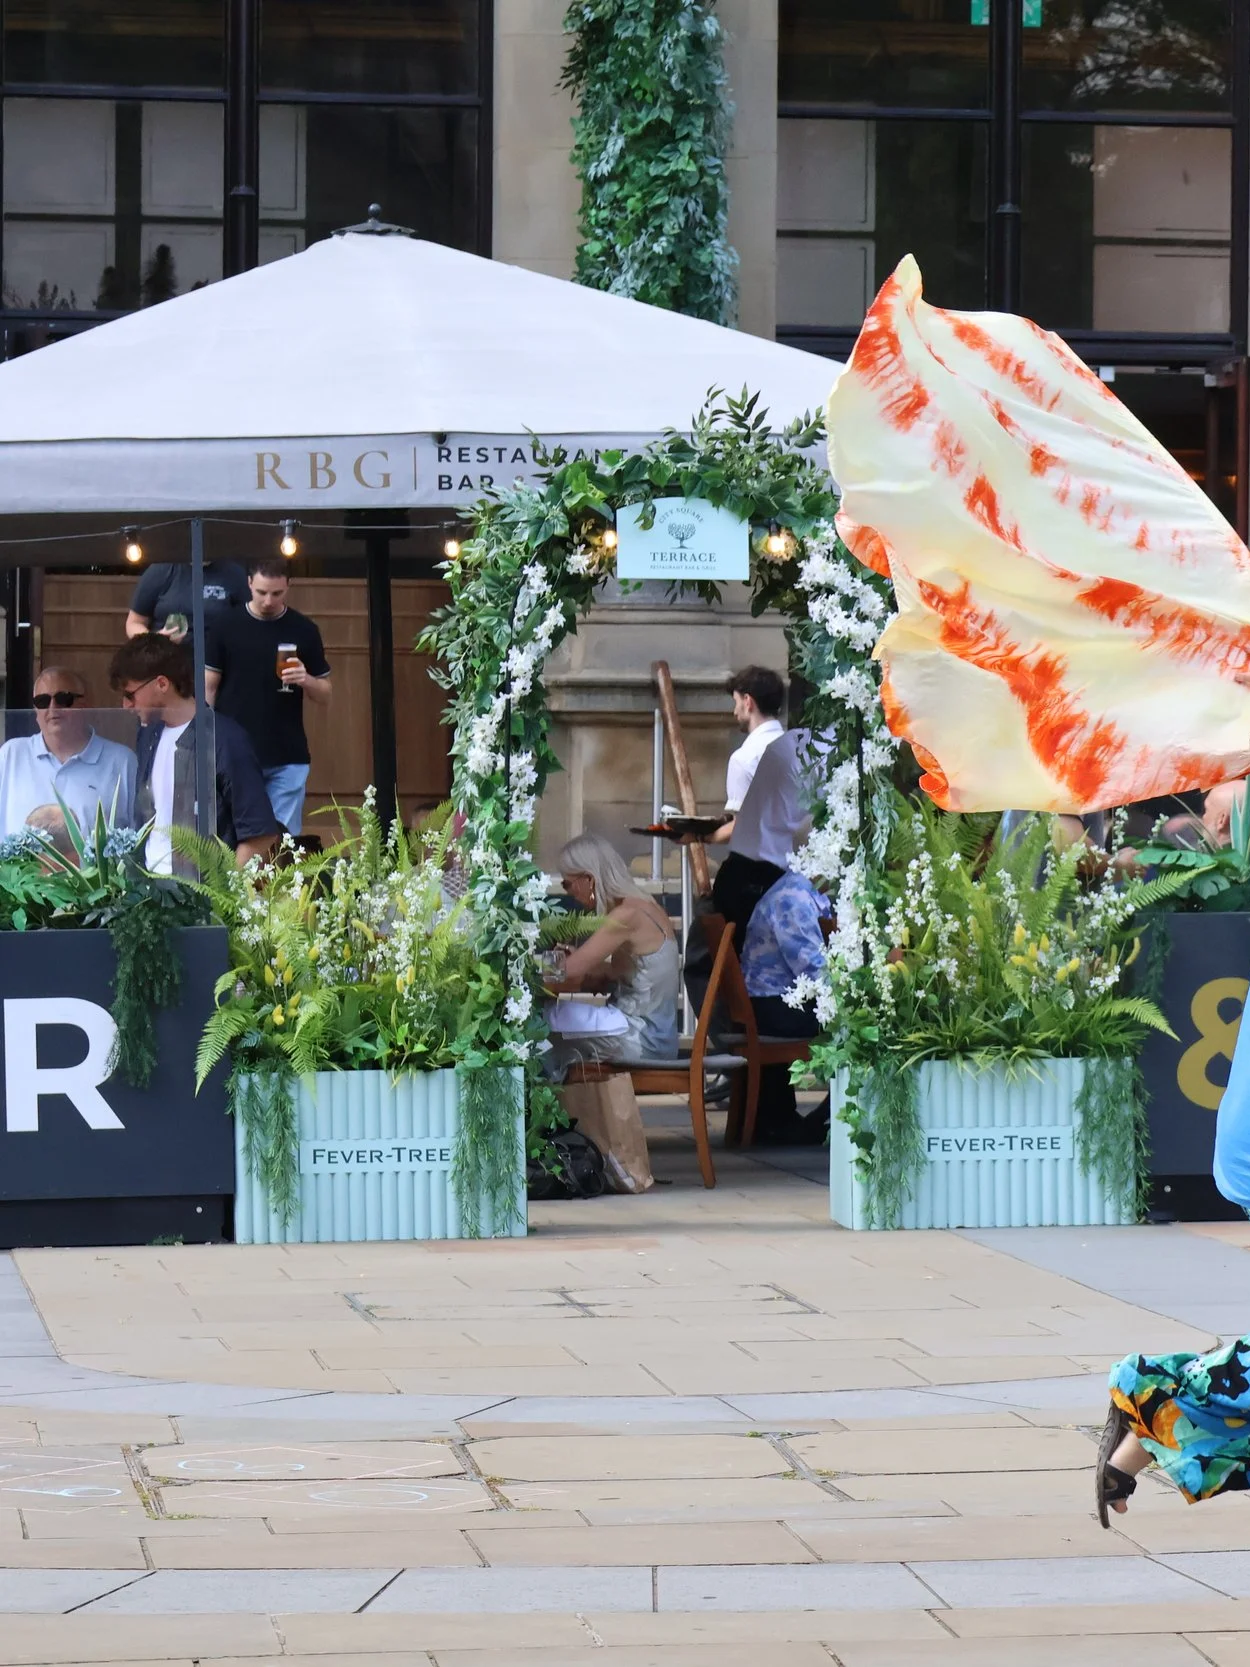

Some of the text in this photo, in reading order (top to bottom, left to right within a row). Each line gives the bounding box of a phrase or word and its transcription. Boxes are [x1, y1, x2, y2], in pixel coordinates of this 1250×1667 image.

[255, 450, 392, 491] RBG
[438, 474, 495, 491] BAR
[659, 509, 674, 524] CITY
[650, 551, 717, 563] TERRACE
[926, 1134, 1062, 1153] FEVER-TREE
[312, 1146, 451, 1165] FEVER-TREE
